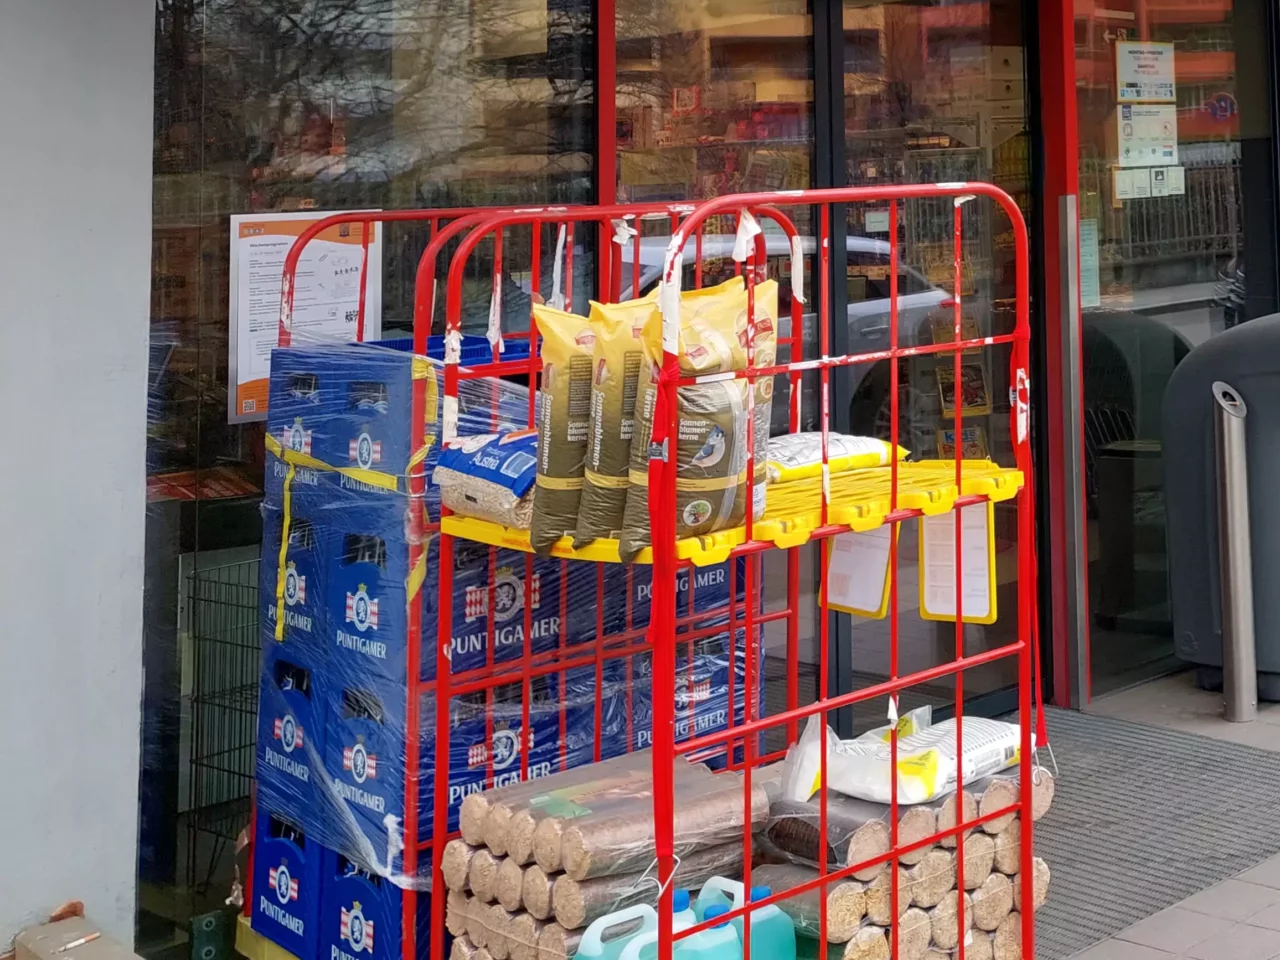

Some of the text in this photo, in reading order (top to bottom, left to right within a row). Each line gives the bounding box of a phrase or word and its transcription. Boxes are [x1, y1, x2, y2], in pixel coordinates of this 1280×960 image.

[679, 418, 710, 426] Sonnen-
[944, 429, 980, 442] kds
[678, 433, 699, 441] kerne
[273, 461, 319, 487] PUNGAMER
[637, 568, 725, 601] PUIGMER
[268, 604, 313, 633] PUTIGAMER
[336, 630, 387, 659] PUNTIGAMER
[637, 709, 726, 748] PUIGMER
[265, 746, 311, 783] PUNTIGAMER
[334, 778, 386, 814] PUNTIGAMER
[260, 895, 304, 937] PUNTIGAMER
